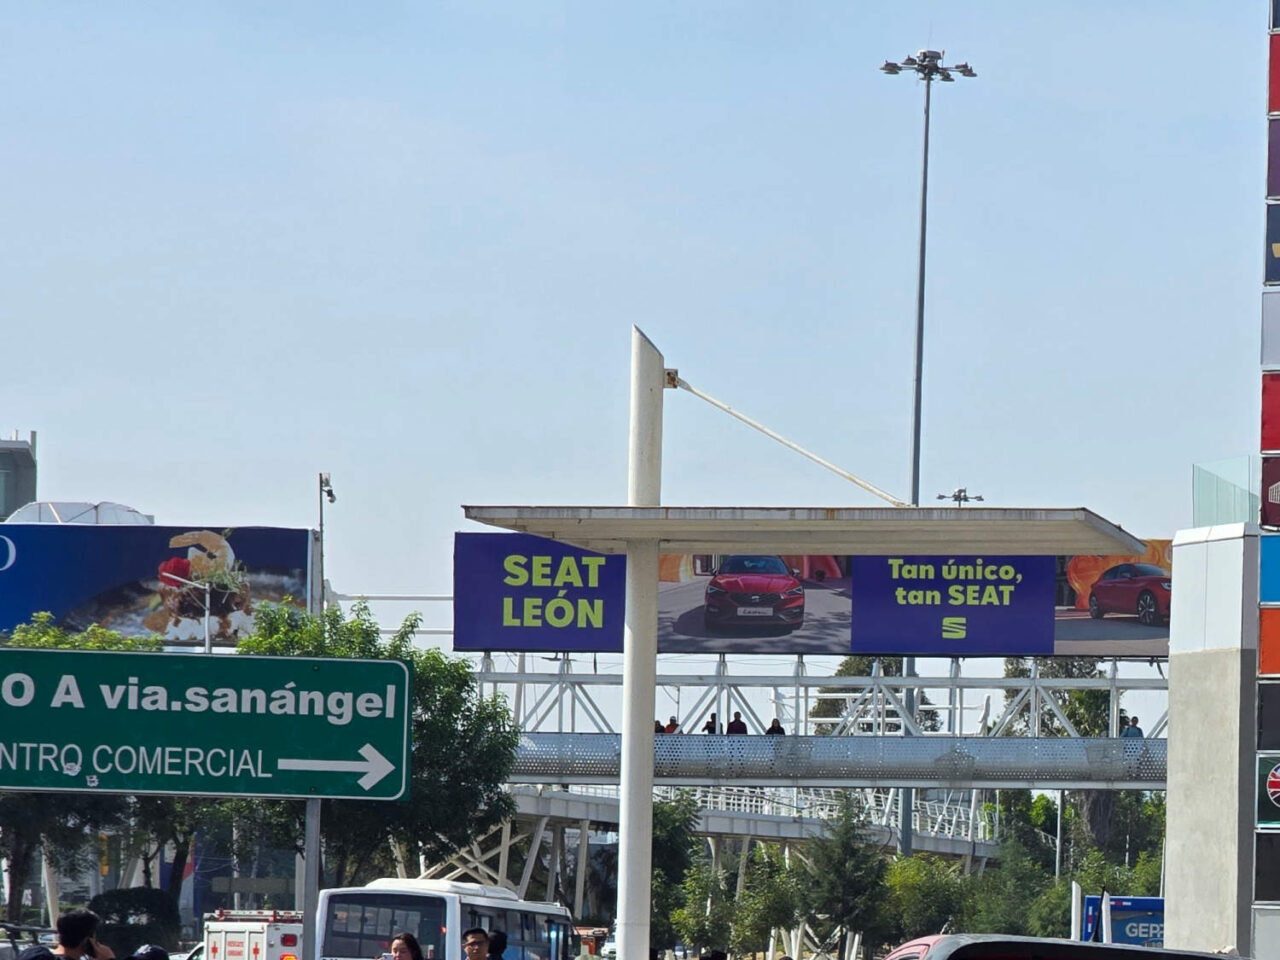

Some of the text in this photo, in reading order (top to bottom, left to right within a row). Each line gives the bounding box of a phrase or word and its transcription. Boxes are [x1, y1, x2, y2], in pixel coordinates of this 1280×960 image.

[503, 554, 606, 587] SEAT
[888, 558, 1023, 584] Tan único,
[503, 589, 603, 628] LEÓN
[895, 585, 1015, 606] tan SEAT
[1, 673, 396, 725] O A via.sanángel
[92, 745, 273, 778] COMERCIAL
[1125, 922, 1165, 938] GEP
